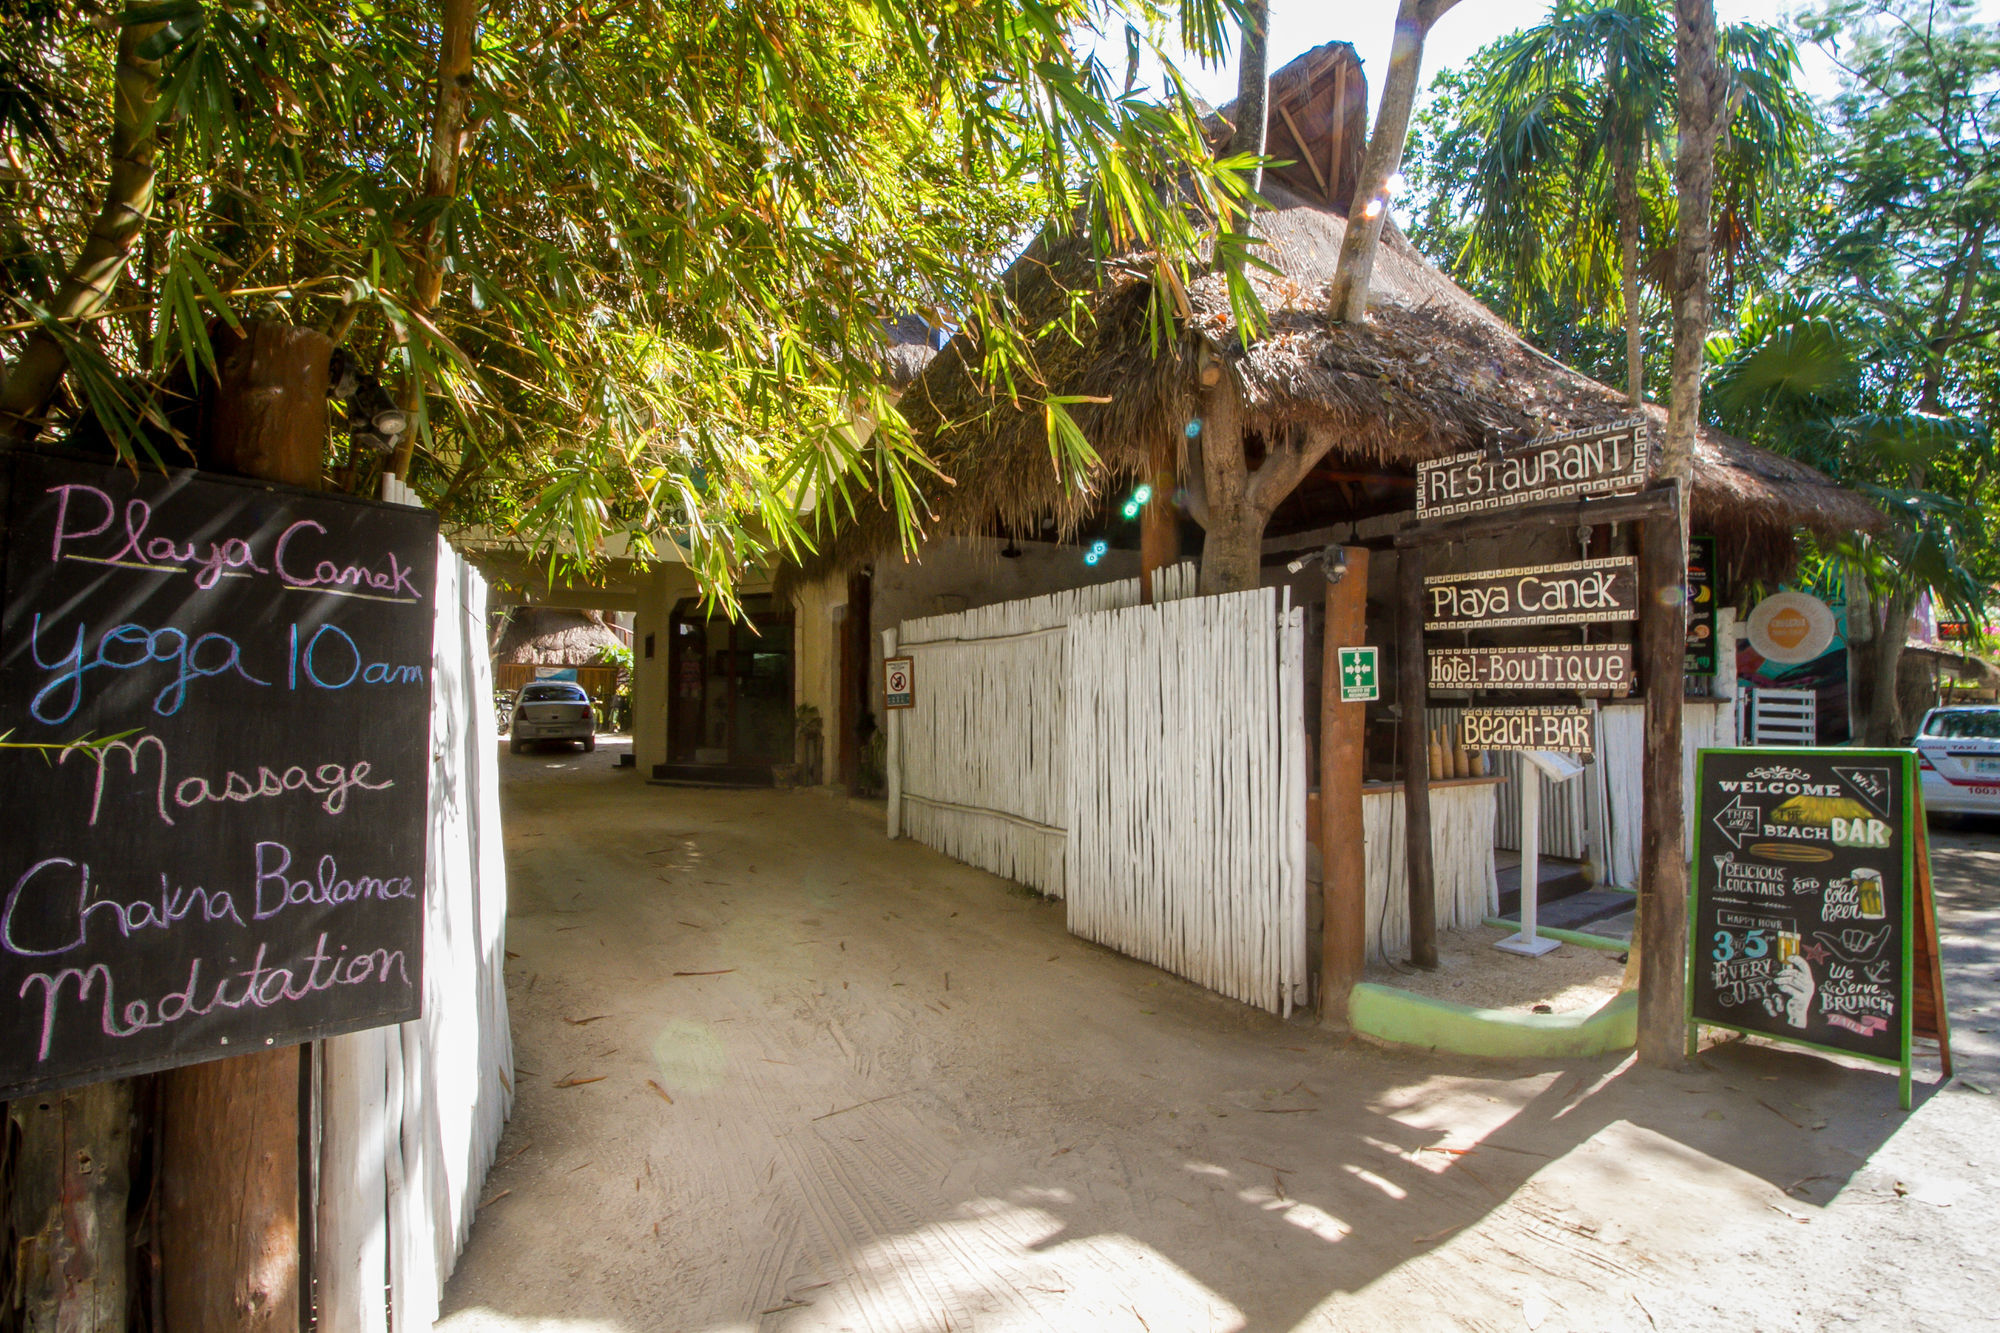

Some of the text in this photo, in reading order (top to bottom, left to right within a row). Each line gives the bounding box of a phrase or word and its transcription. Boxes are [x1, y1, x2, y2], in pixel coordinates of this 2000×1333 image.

[46, 484, 422, 598] Playa Canek
[1429, 572, 1620, 618] Playa Canek
[288, 622, 425, 691] 10am
[59, 735, 396, 826] Massage
[1719, 781, 1841, 797] WELCOME
[1725, 809, 1754, 820] THIS
[1779, 808, 1803, 820] THE
[1763, 817, 1886, 845] BEACH BAR
[1725, 863, 1785, 882] DELICIOUS
[1726, 879, 1785, 896] COCKTAILS
[1792, 879, 1820, 892] AND
[1, 857, 246, 956] Chakra
[1727, 914, 1782, 930] HAPPY HOUR
[1712, 930, 1734, 961] 3
[1744, 929, 1768, 958] 5
[1711, 959, 1773, 989] EVERY
[1829, 962, 1854, 979] We
[20, 932, 413, 1061] Meditation
[1729, 980, 1772, 1004] DAY
[1835, 979, 1880, 995] Serve
[1820, 992, 1894, 1015] BRUNCH
